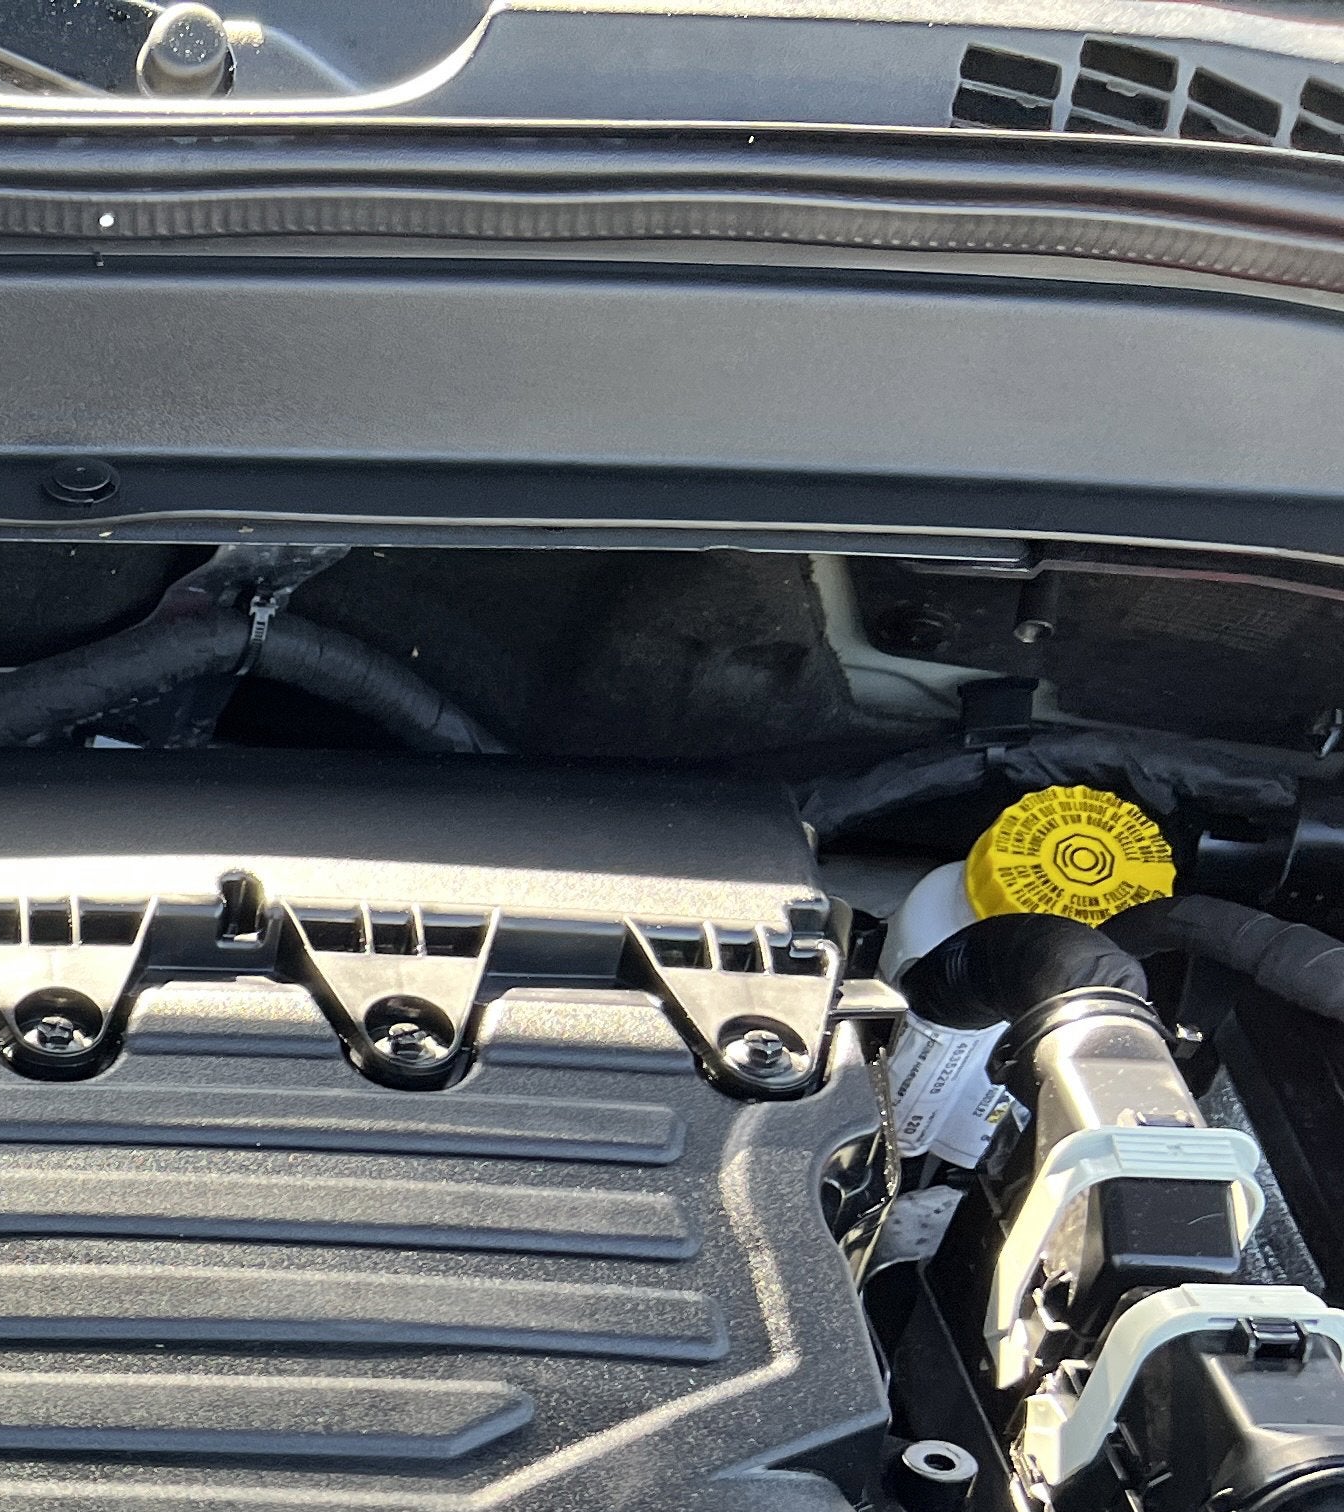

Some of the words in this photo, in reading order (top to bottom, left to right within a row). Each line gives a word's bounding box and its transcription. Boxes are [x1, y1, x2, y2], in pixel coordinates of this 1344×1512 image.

[1013, 864, 1031, 879] CAP
[1023, 880, 1059, 911] BEFORE
[1013, 888, 1040, 911] FLUID
[1070, 893, 1100, 907] CLEAN
[1103, 880, 1135, 904] FILLER
